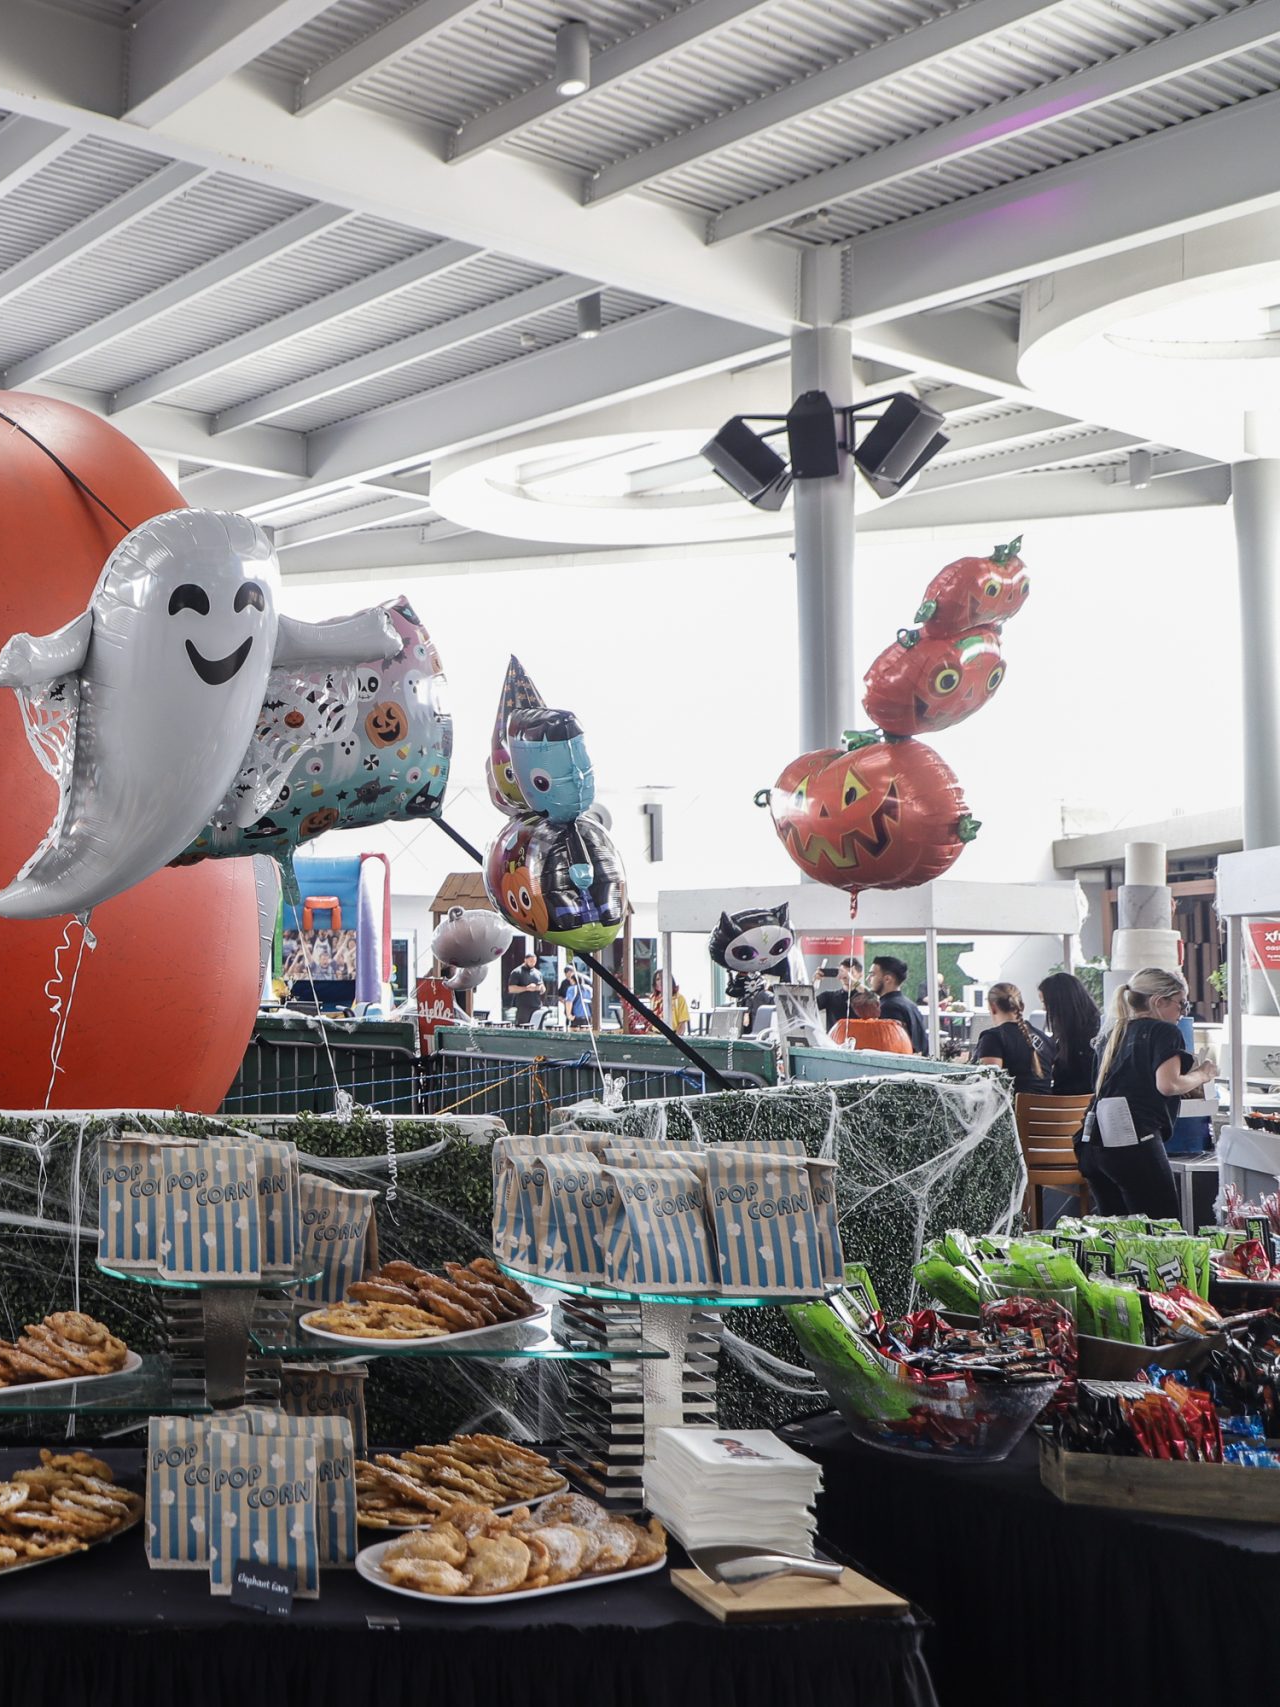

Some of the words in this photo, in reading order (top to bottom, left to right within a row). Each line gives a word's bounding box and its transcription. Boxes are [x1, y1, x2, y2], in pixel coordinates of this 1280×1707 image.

[419, 999, 454, 1024] Hello
[102, 1163, 143, 1185] POP
[166, 1168, 208, 1193] POP
[259, 1174, 287, 1196] RN
[521, 1168, 546, 1191] PO
[553, 1171, 589, 1197] POP
[130, 1178, 161, 1198] CO
[196, 1180, 253, 1207] CORN
[581, 1184, 615, 1209] COR
[623, 1180, 659, 1204] POP
[715, 1181, 758, 1206] POP
[653, 1190, 704, 1217] CORN
[747, 1190, 808, 1220] CORN
[301, 1207, 330, 1226] OP
[314, 1221, 365, 1241] CORN
[307, 1386, 358, 1412] CORN
[152, 1443, 198, 1472] POP
[320, 1456, 350, 1481] RN
[183, 1463, 210, 1487] CO
[212, 1464, 262, 1493] POP
[247, 1480, 313, 1510] CORN
[237, 1572, 270, 1590] Elephant
